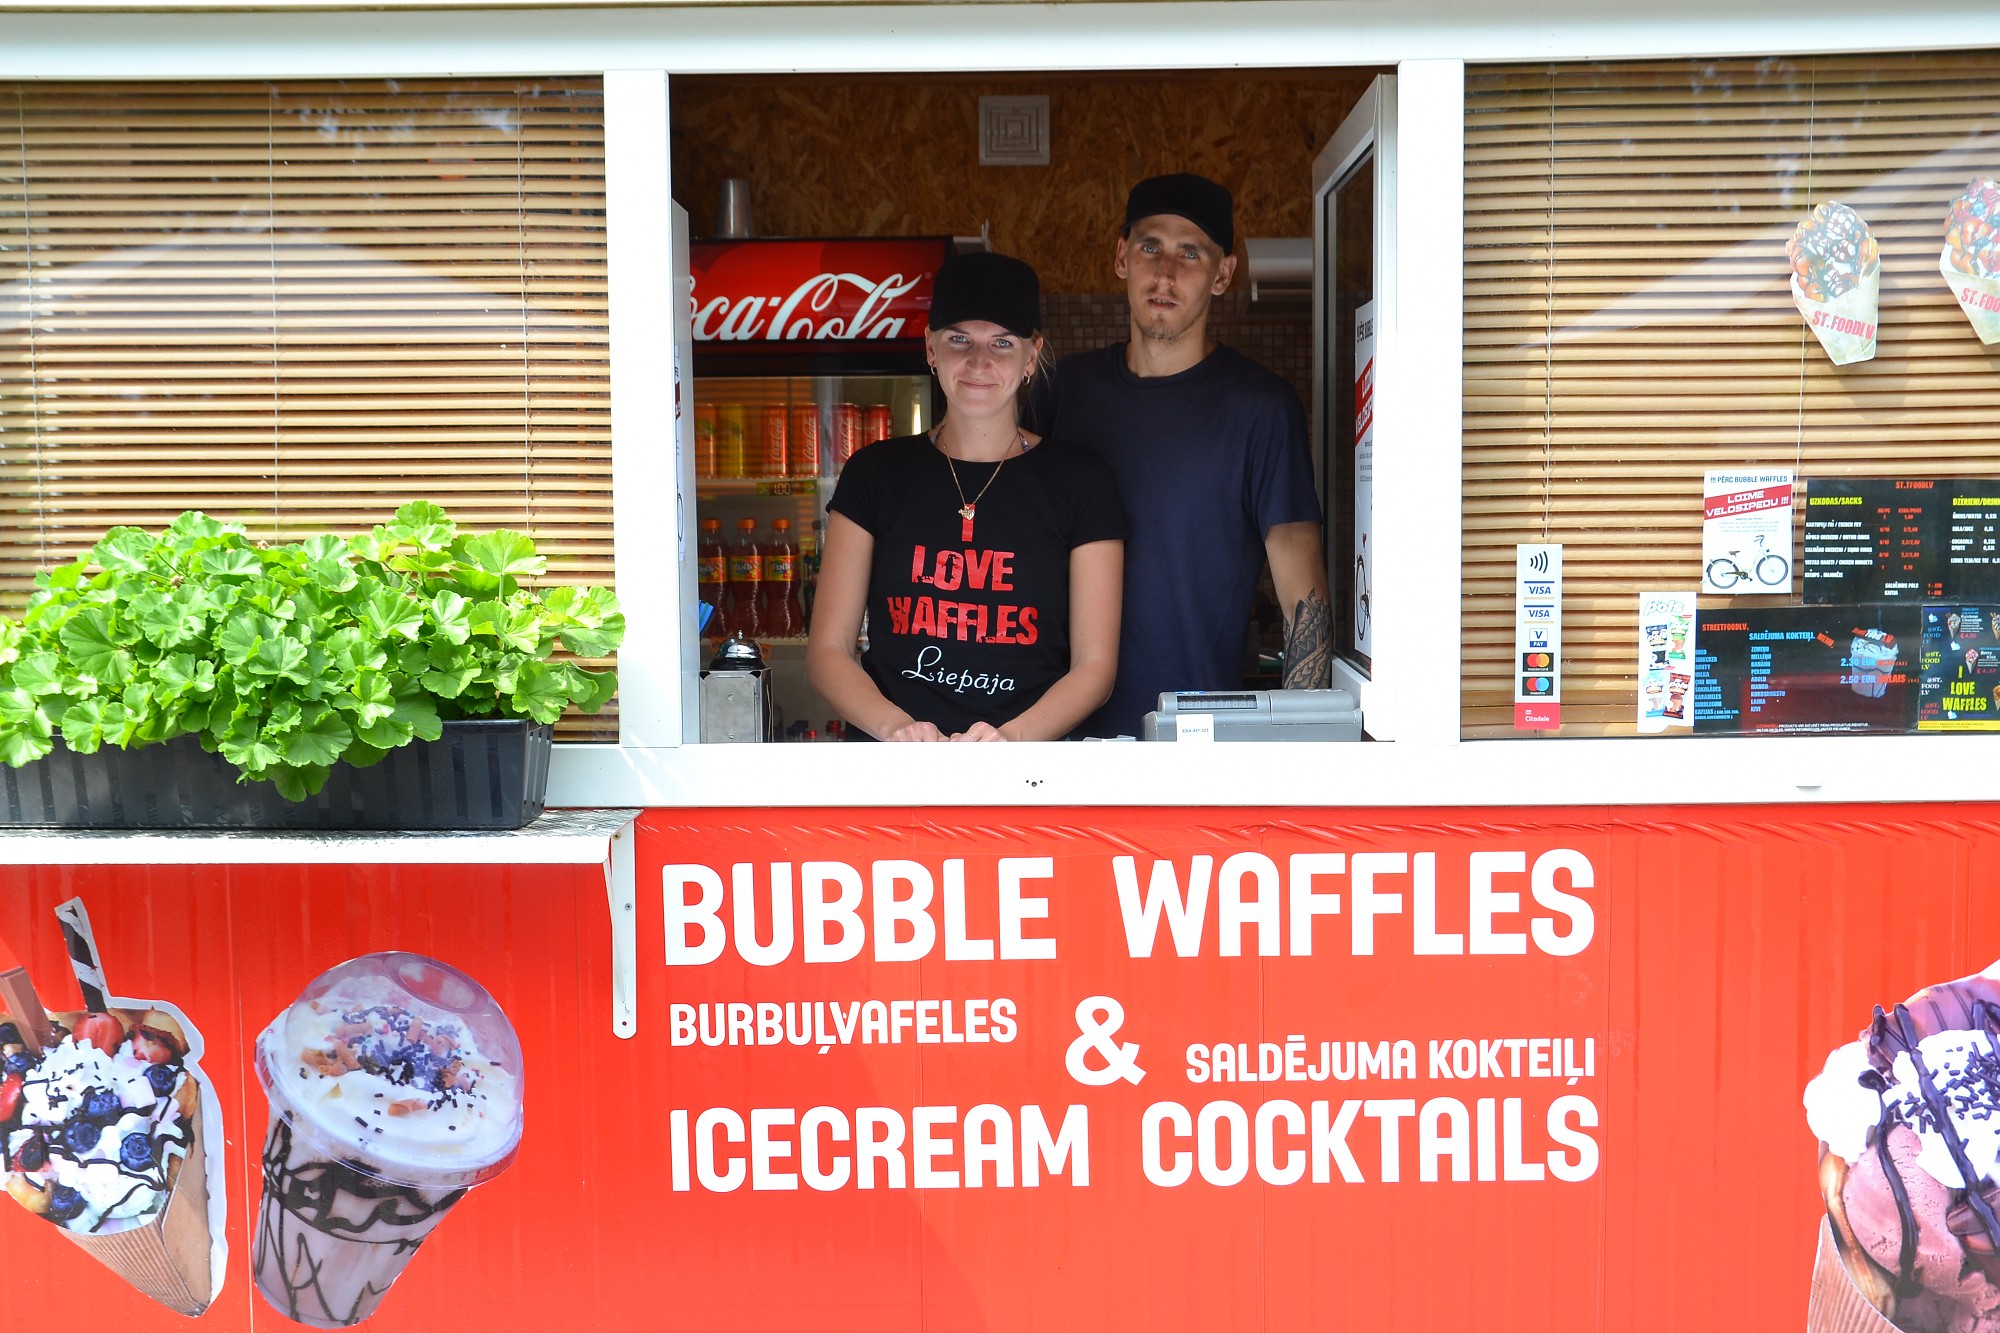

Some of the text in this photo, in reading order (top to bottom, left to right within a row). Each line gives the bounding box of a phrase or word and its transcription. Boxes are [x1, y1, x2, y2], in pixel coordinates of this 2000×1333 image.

[912, 544, 1015, 591] LOVE
[1528, 586, 1551, 595] VISA
[886, 596, 1039, 645] WAFFLES
[1528, 609, 1550, 618] VISA
[1534, 631, 1543, 639] V
[1840, 658, 1859, 666] 2.30
[1862, 657, 1876, 666] EUR
[901, 645, 1016, 695] Liepāja
[1958, 665, 1963, 678] I
[1840, 675, 1859, 684] 2.50
[1862, 675, 1876, 683] EUR
[1950, 681, 1975, 695] LOVE
[1942, 697, 1987, 711] WAFFLES
[662, 849, 1595, 966] BUBBLE WAFFLES
[669, 996, 1595, 1086] BURBUĻVAFELES & SALDĒJUMA KOKTEIĻI
[669, 1095, 1599, 1192] ICECREAM COCKTAILS
